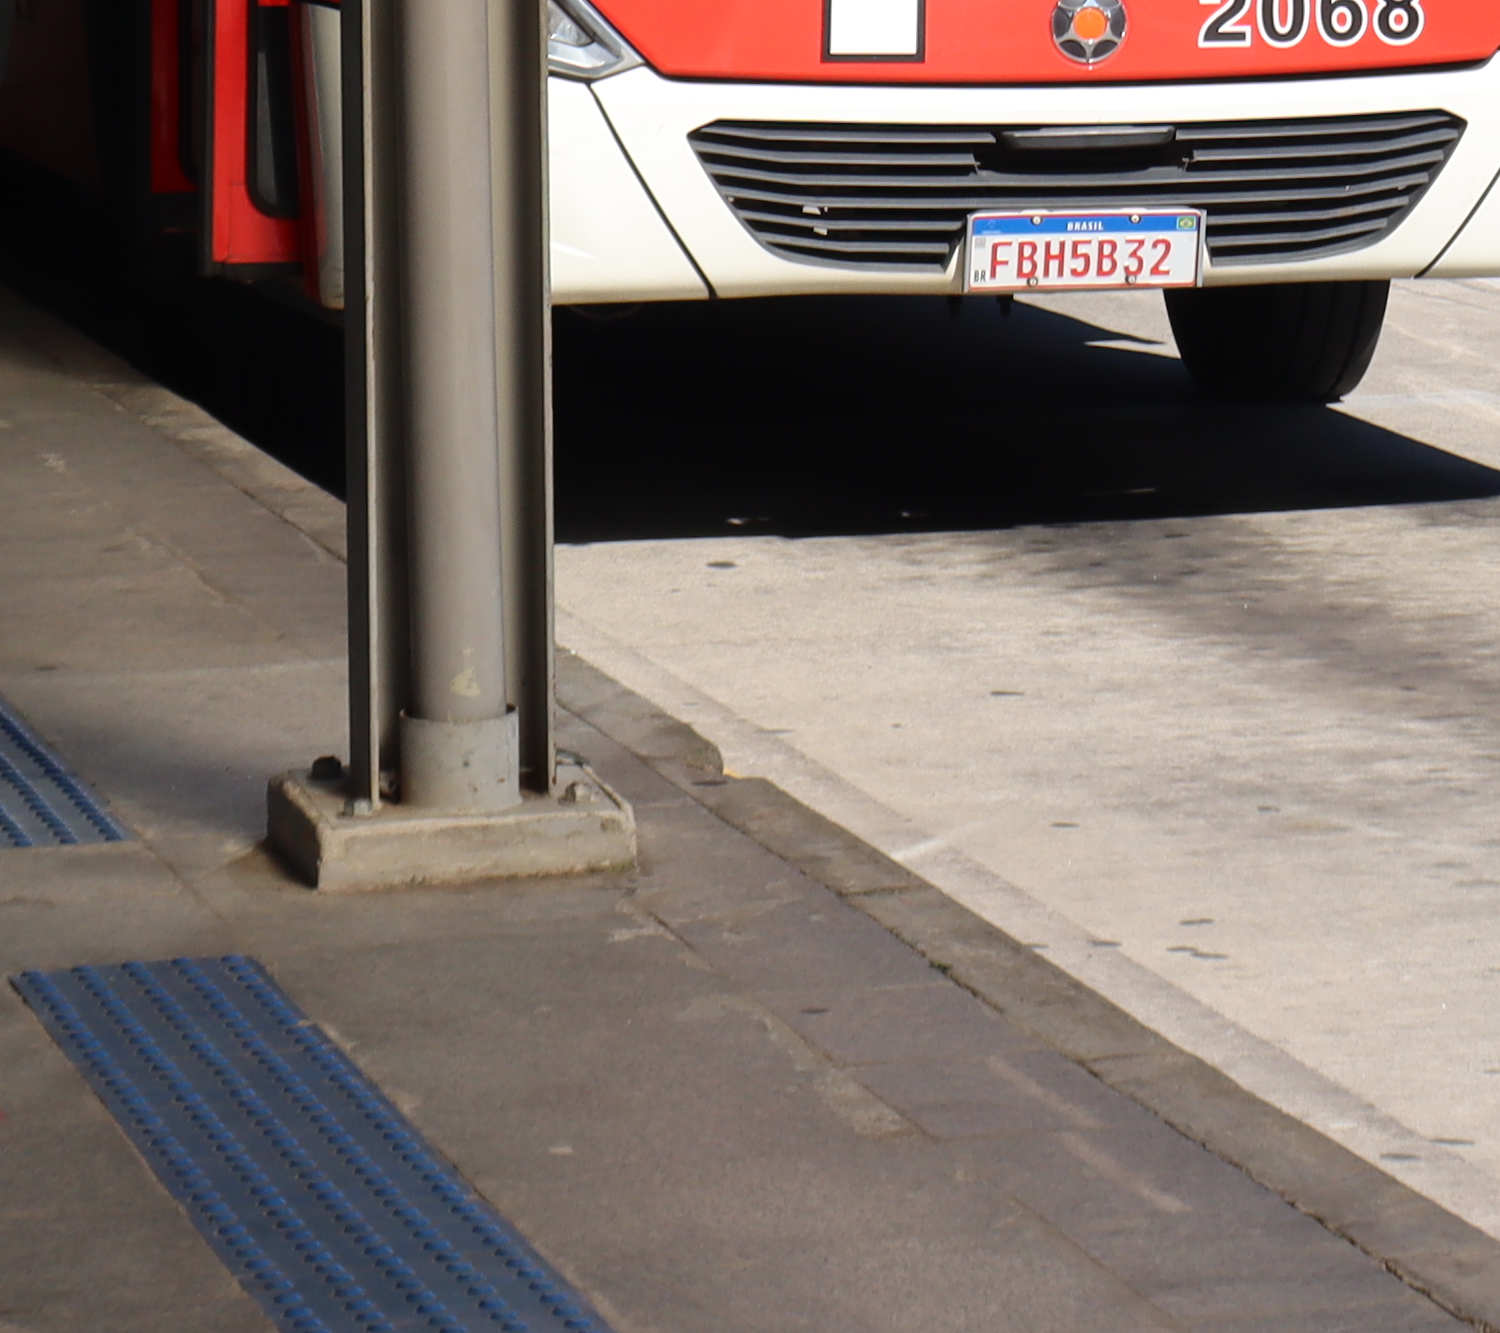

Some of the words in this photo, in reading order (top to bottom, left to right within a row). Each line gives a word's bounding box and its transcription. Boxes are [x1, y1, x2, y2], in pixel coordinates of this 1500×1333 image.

[1066, 221, 1105, 232] BRASIL
[989, 237, 1174, 280] FBH5B32
[973, 269, 987, 283] BR
